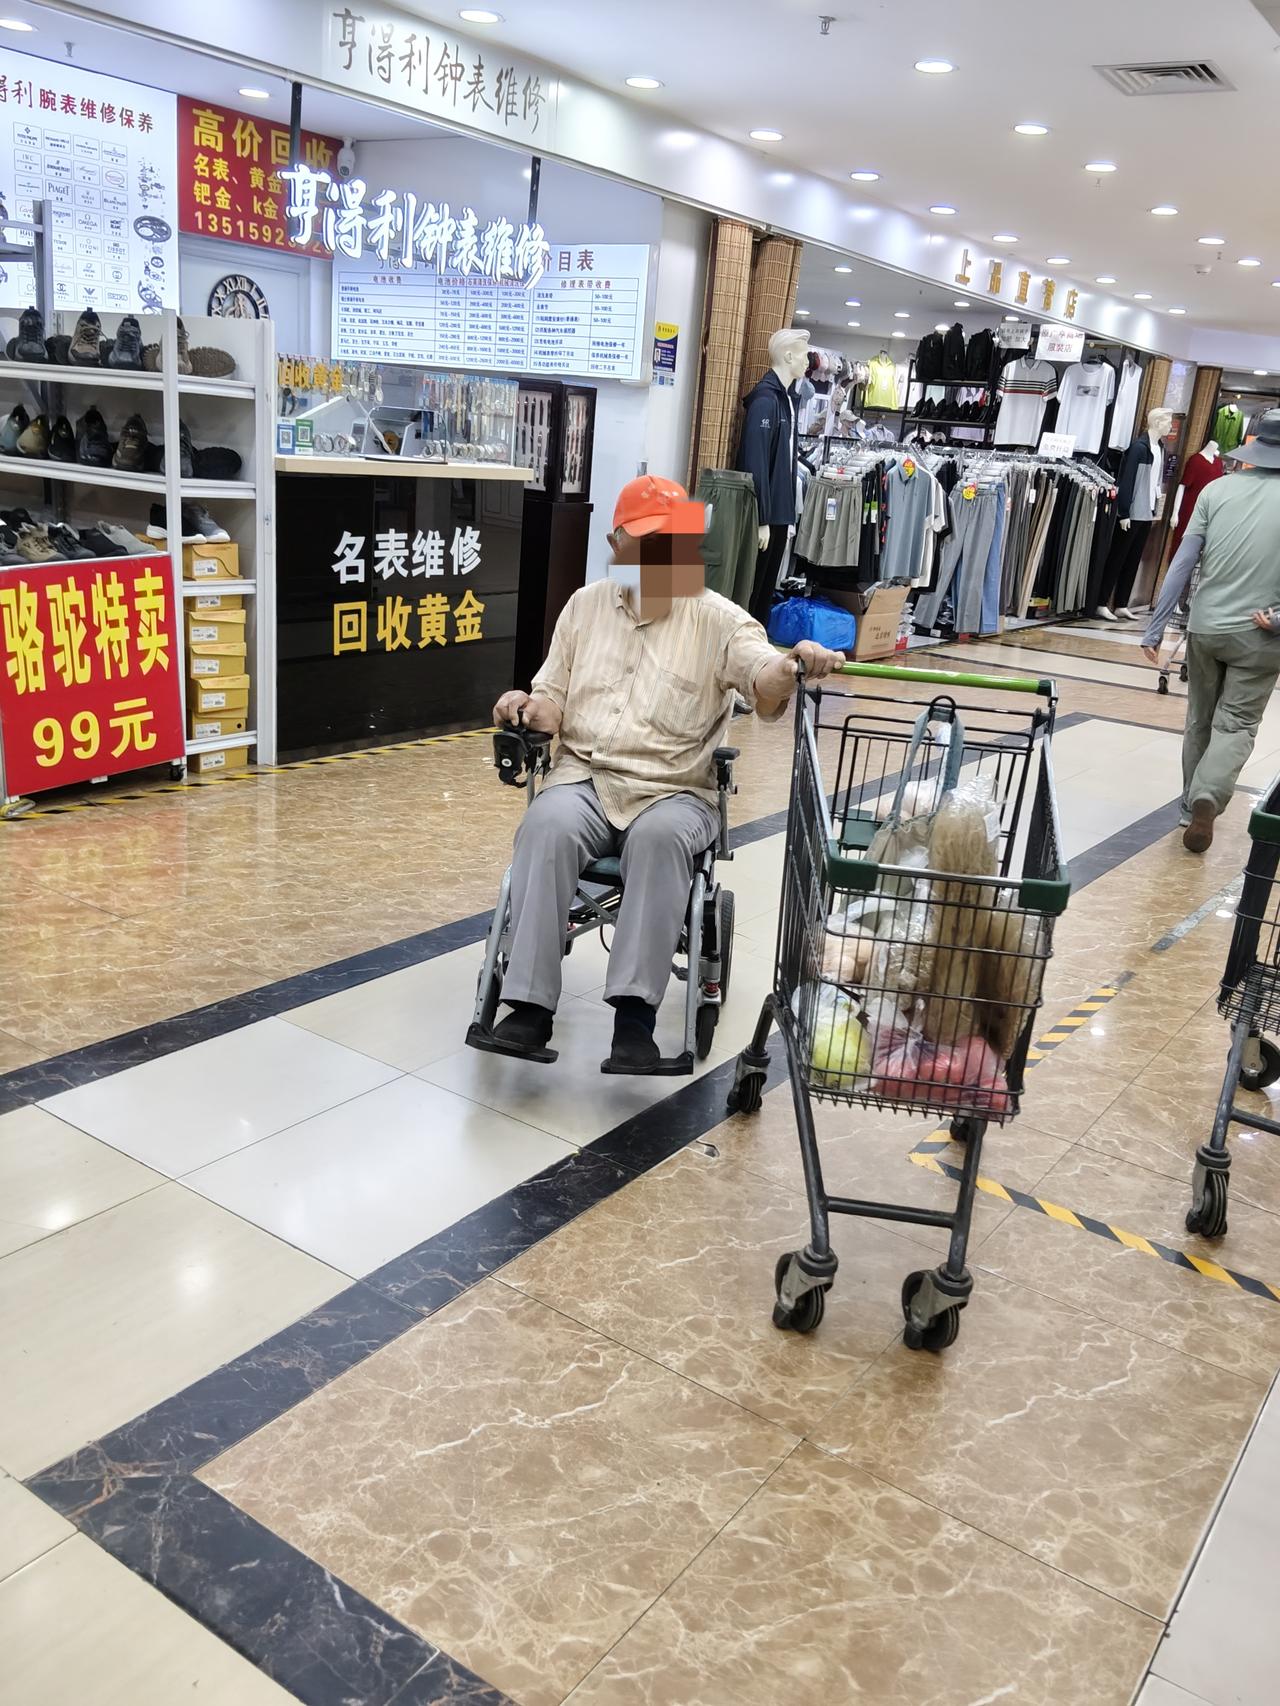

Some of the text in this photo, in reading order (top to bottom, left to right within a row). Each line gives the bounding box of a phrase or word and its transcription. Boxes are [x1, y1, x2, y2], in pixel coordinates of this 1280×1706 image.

[332, 7, 546, 134] 亨得利钟表维修
[192, 108, 334, 168] 高价回收
[48, 182, 70, 197] PIAGET
[193, 153, 288, 194] 名表、黄金
[78, 219, 98, 228] OMEGA
[277, 163, 550, 290] 亨得利钟表维修
[278, 361, 344, 392] 回收黄金
[331, 526, 482, 584] 名表维修
[0, 567, 170, 696] 骆驼特卖
[333, 589, 485, 656] 回收黄金
[32, 697, 158, 768] 99元
